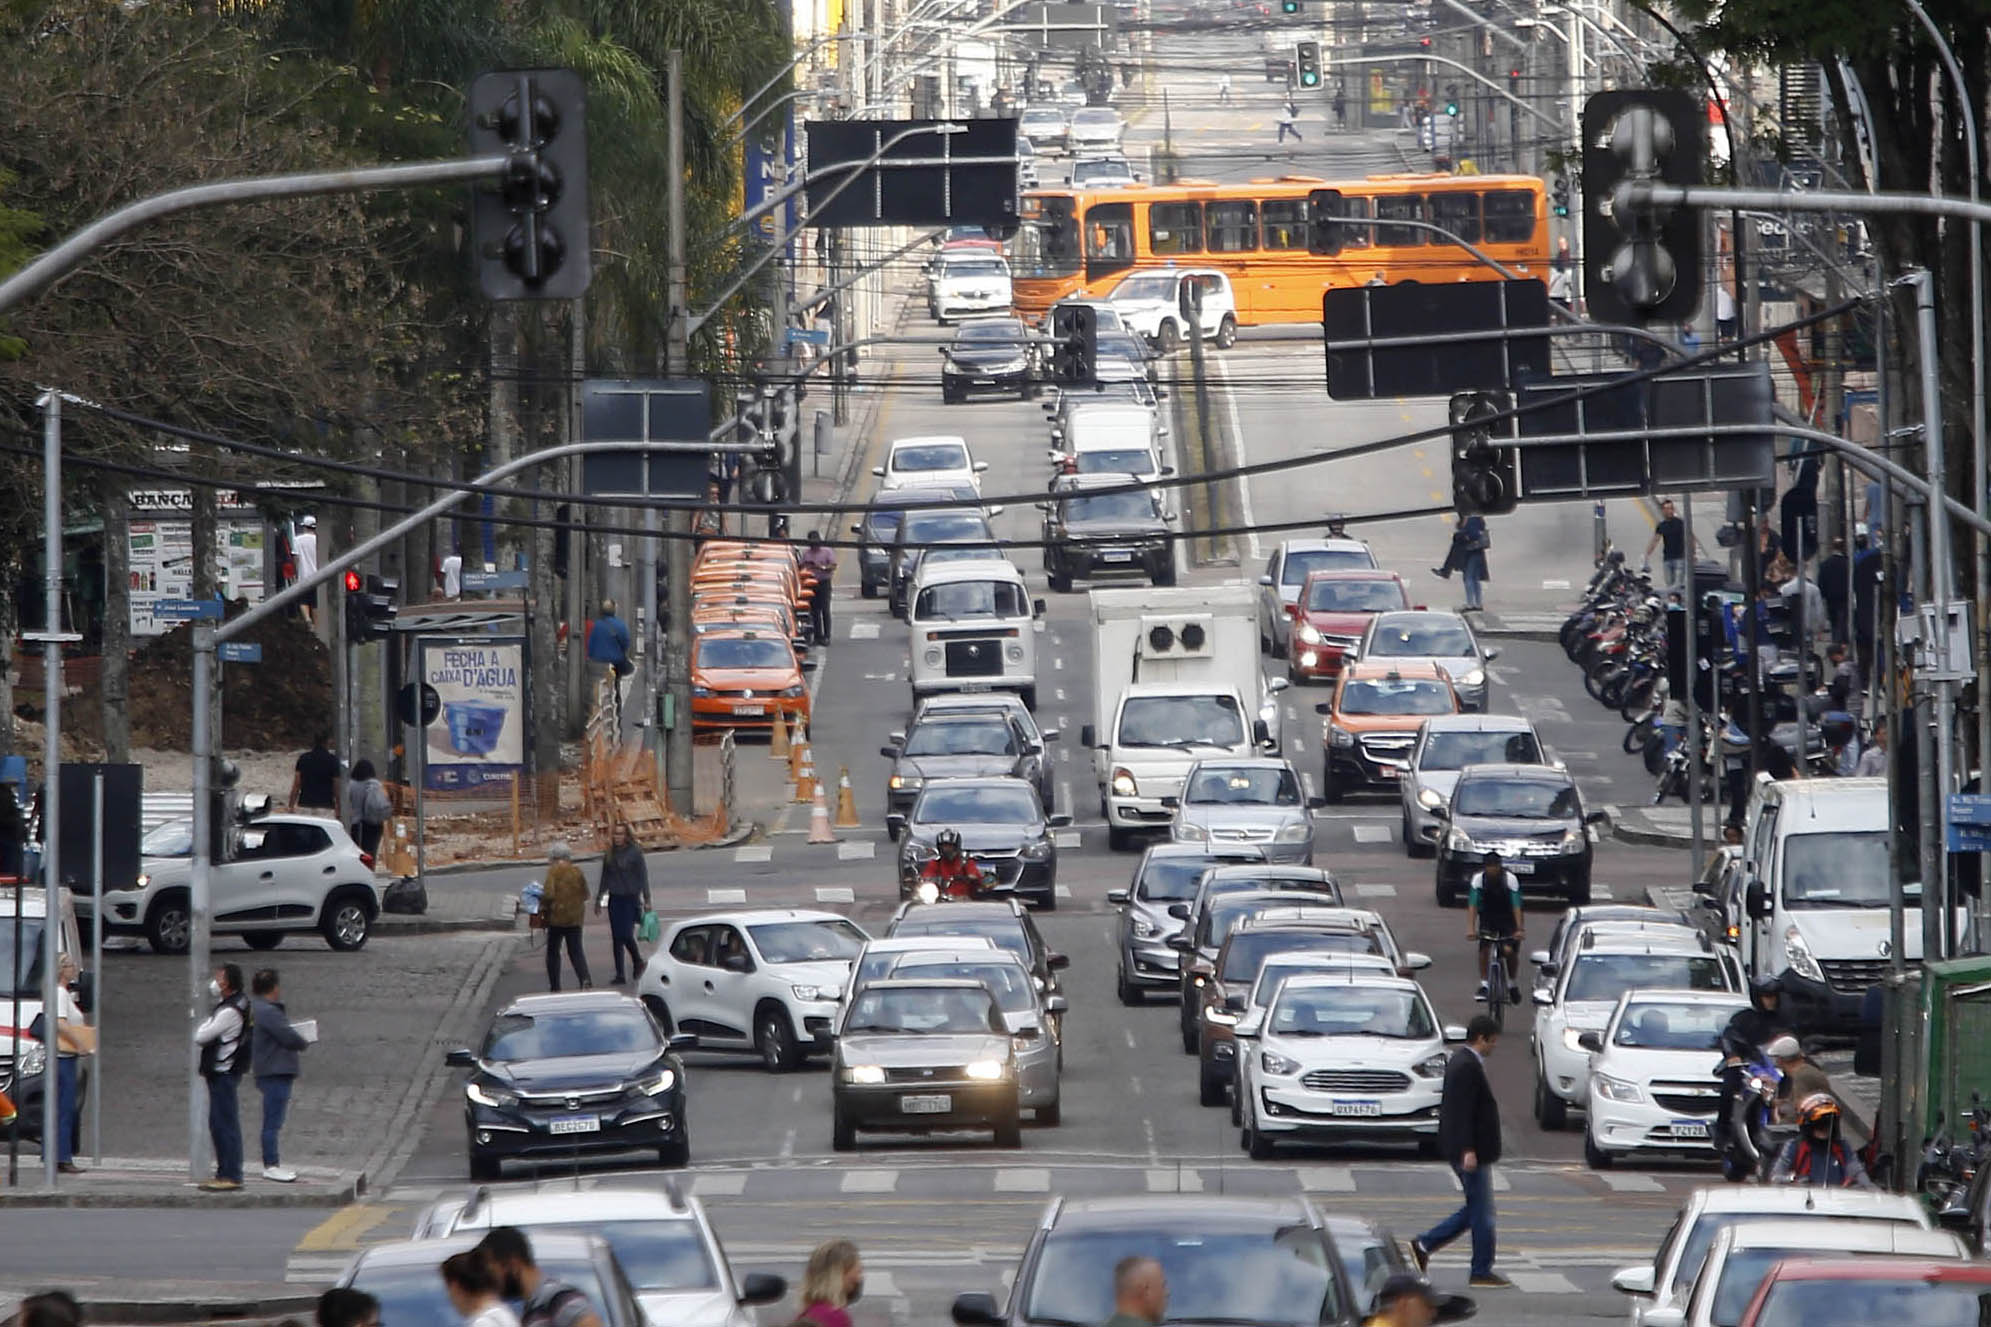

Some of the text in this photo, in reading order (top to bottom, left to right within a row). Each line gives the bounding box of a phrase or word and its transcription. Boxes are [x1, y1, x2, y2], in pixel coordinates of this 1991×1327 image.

[135, 494, 192, 507] BANCA
[444, 651, 499, 668] FECHA A
[431, 669, 462, 684] CAIXA
